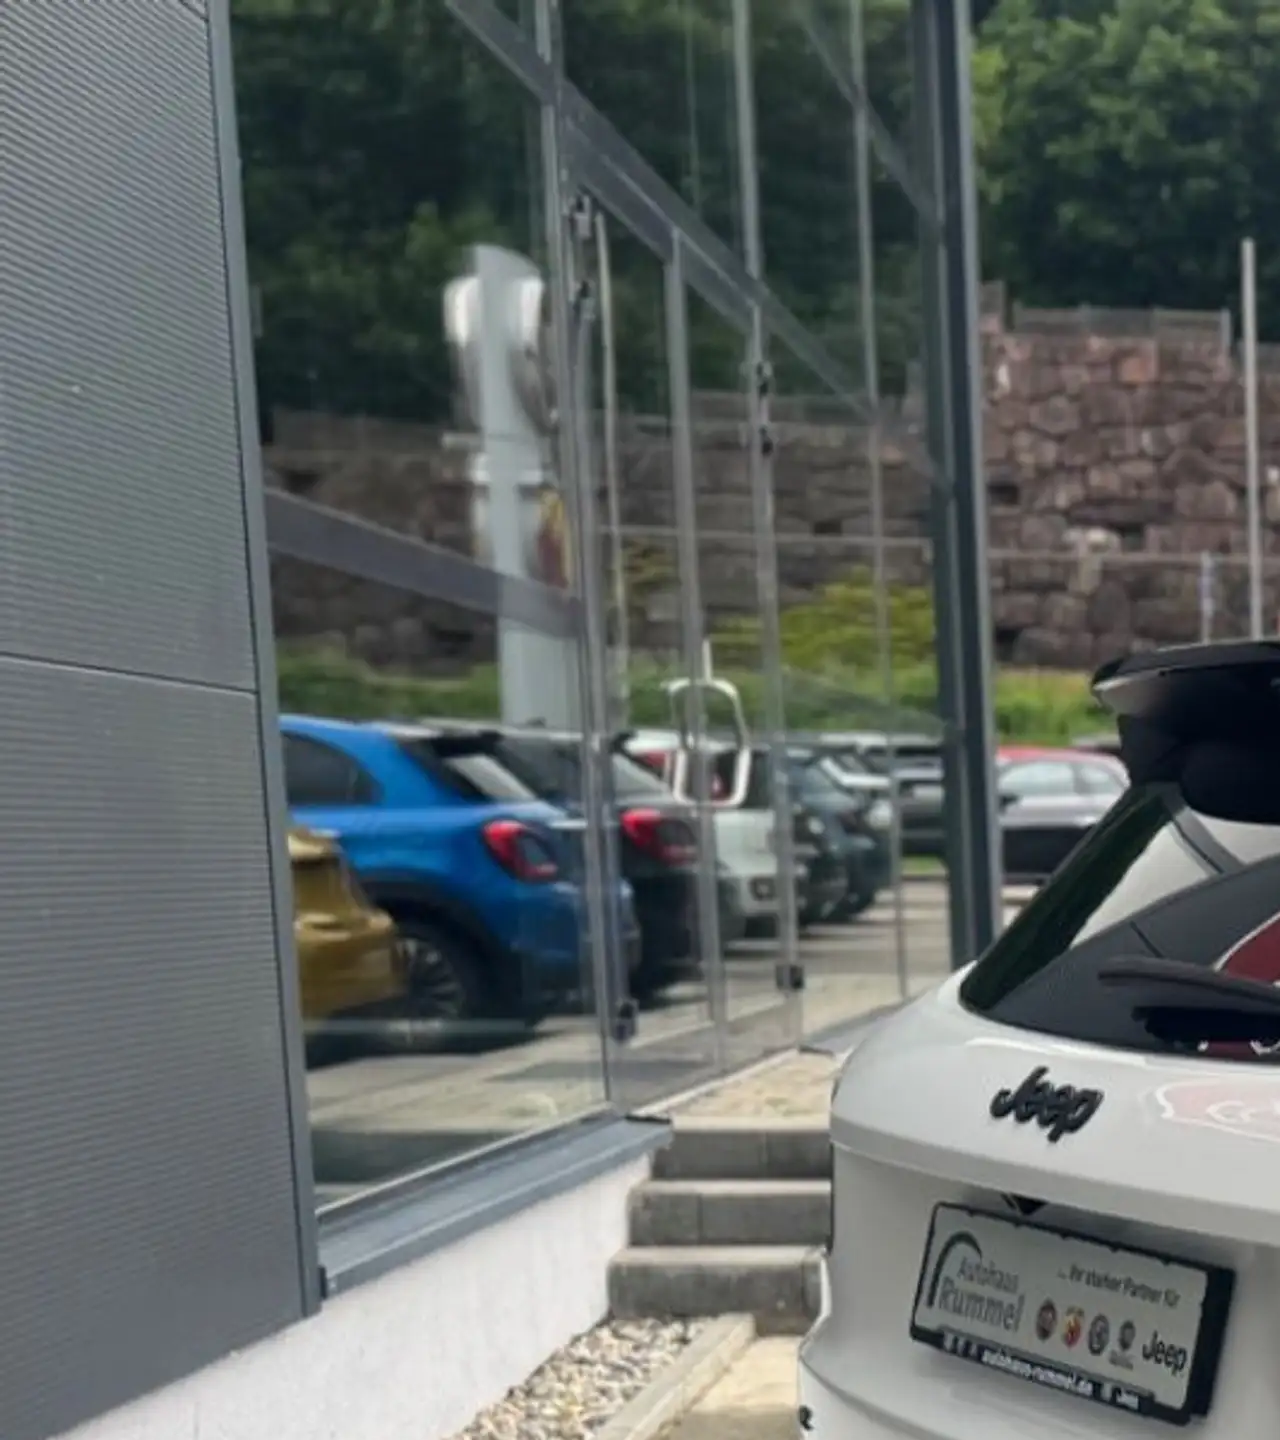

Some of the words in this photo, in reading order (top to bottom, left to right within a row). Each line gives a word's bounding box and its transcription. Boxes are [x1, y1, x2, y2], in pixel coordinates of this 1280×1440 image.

[989, 1066, 1105, 1143] Jeep
[957, 1256, 1018, 1295] Autohaus
[940, 1276, 1025, 1333] Rummel
[1142, 1329, 1188, 1377] Jeep
